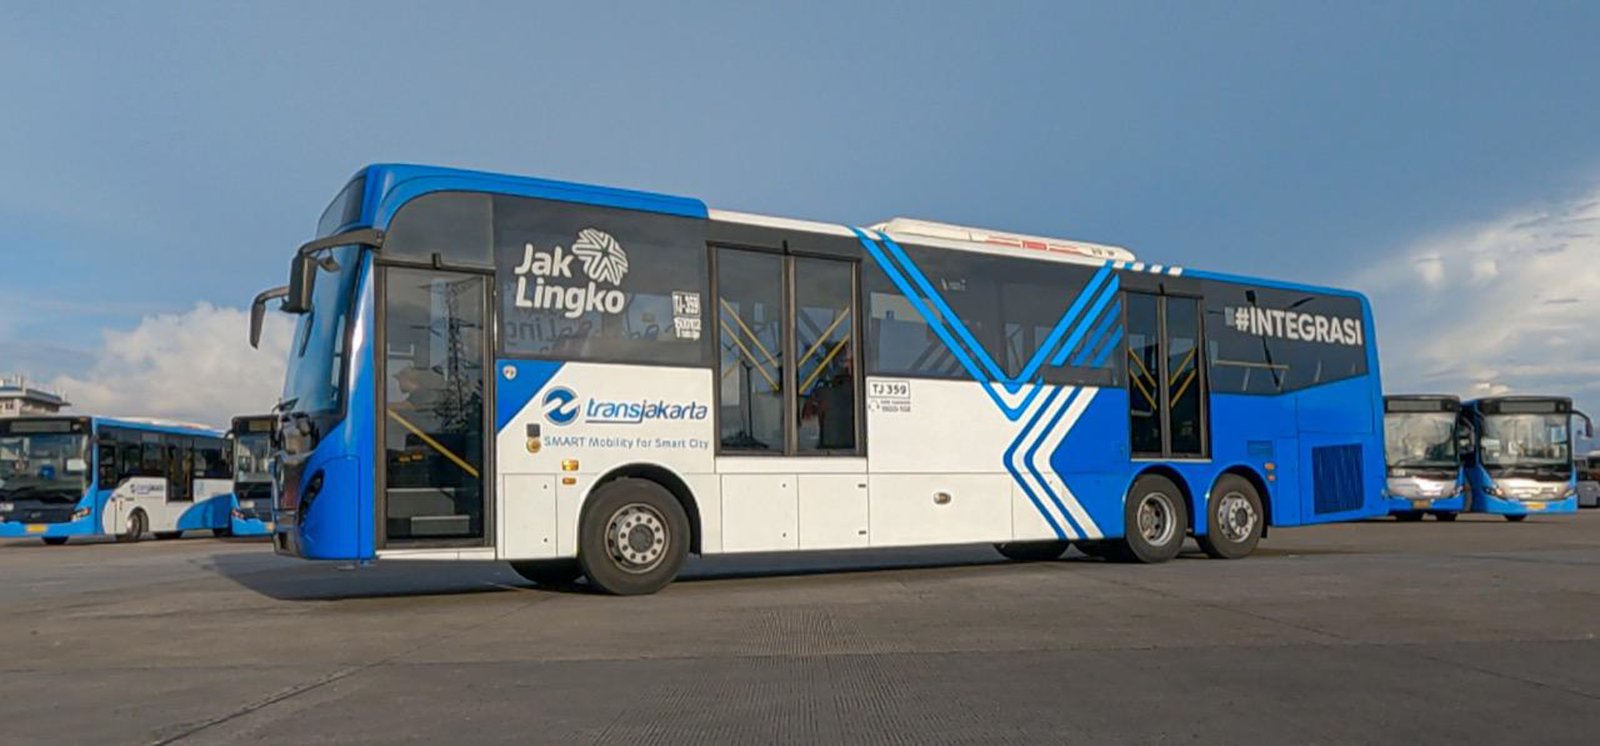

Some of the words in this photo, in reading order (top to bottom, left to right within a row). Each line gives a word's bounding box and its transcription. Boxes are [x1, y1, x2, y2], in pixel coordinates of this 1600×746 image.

[514, 243, 574, 278] Jak
[515, 275, 626, 319] Lingko
[1235, 305, 1363, 346] #INTEGRASI
[872, 383, 885, 395] TJ
[886, 384, 907, 395] 359
[585, 397, 708, 424] transjakarta
[544, 436, 585, 447] SMART
[588, 437, 633, 450] Mobility
[636, 438, 652, 448] for
[655, 438, 685, 448] Smart
[689, 439, 709, 449] City
